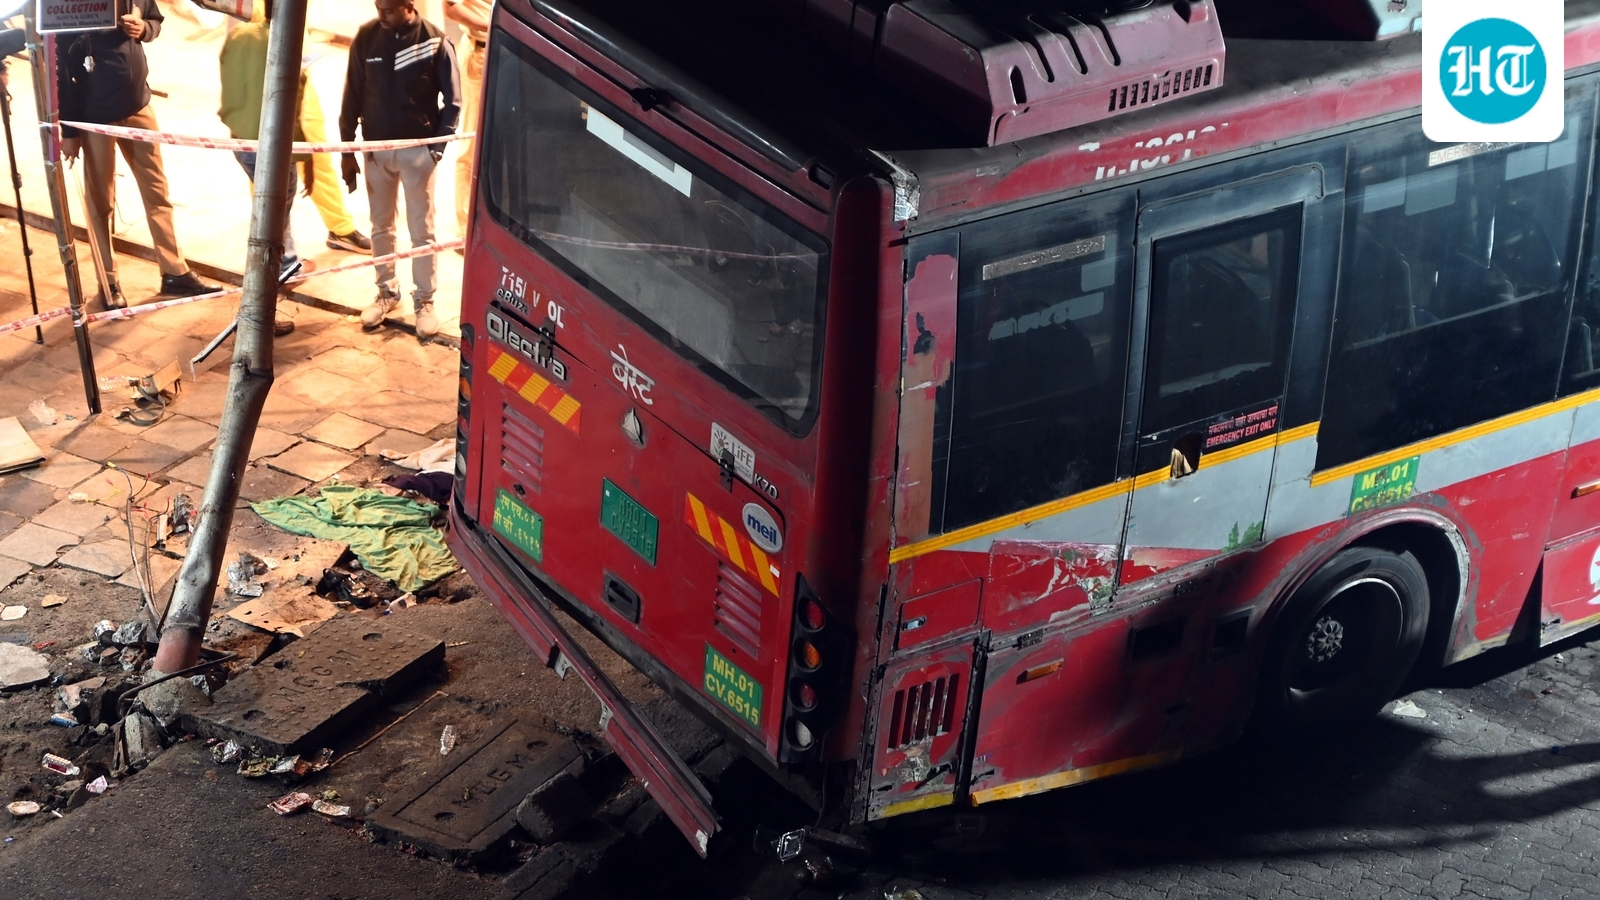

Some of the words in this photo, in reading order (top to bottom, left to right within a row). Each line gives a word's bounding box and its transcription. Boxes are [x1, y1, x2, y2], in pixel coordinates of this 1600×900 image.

[46, 2, 108, 15] COLLECTION
[610, 343, 655, 405] बेस्ट
[1206, 428, 1245, 448] EMERGENCY
[1245, 423, 1260, 437] EXIT
[1259, 417, 1277, 432] ONLY
[731, 441, 753, 469] LiFE
[747, 513, 777, 546] meil
[713, 653, 754, 699] MH.01
[706, 673, 759, 726] CV.6515
